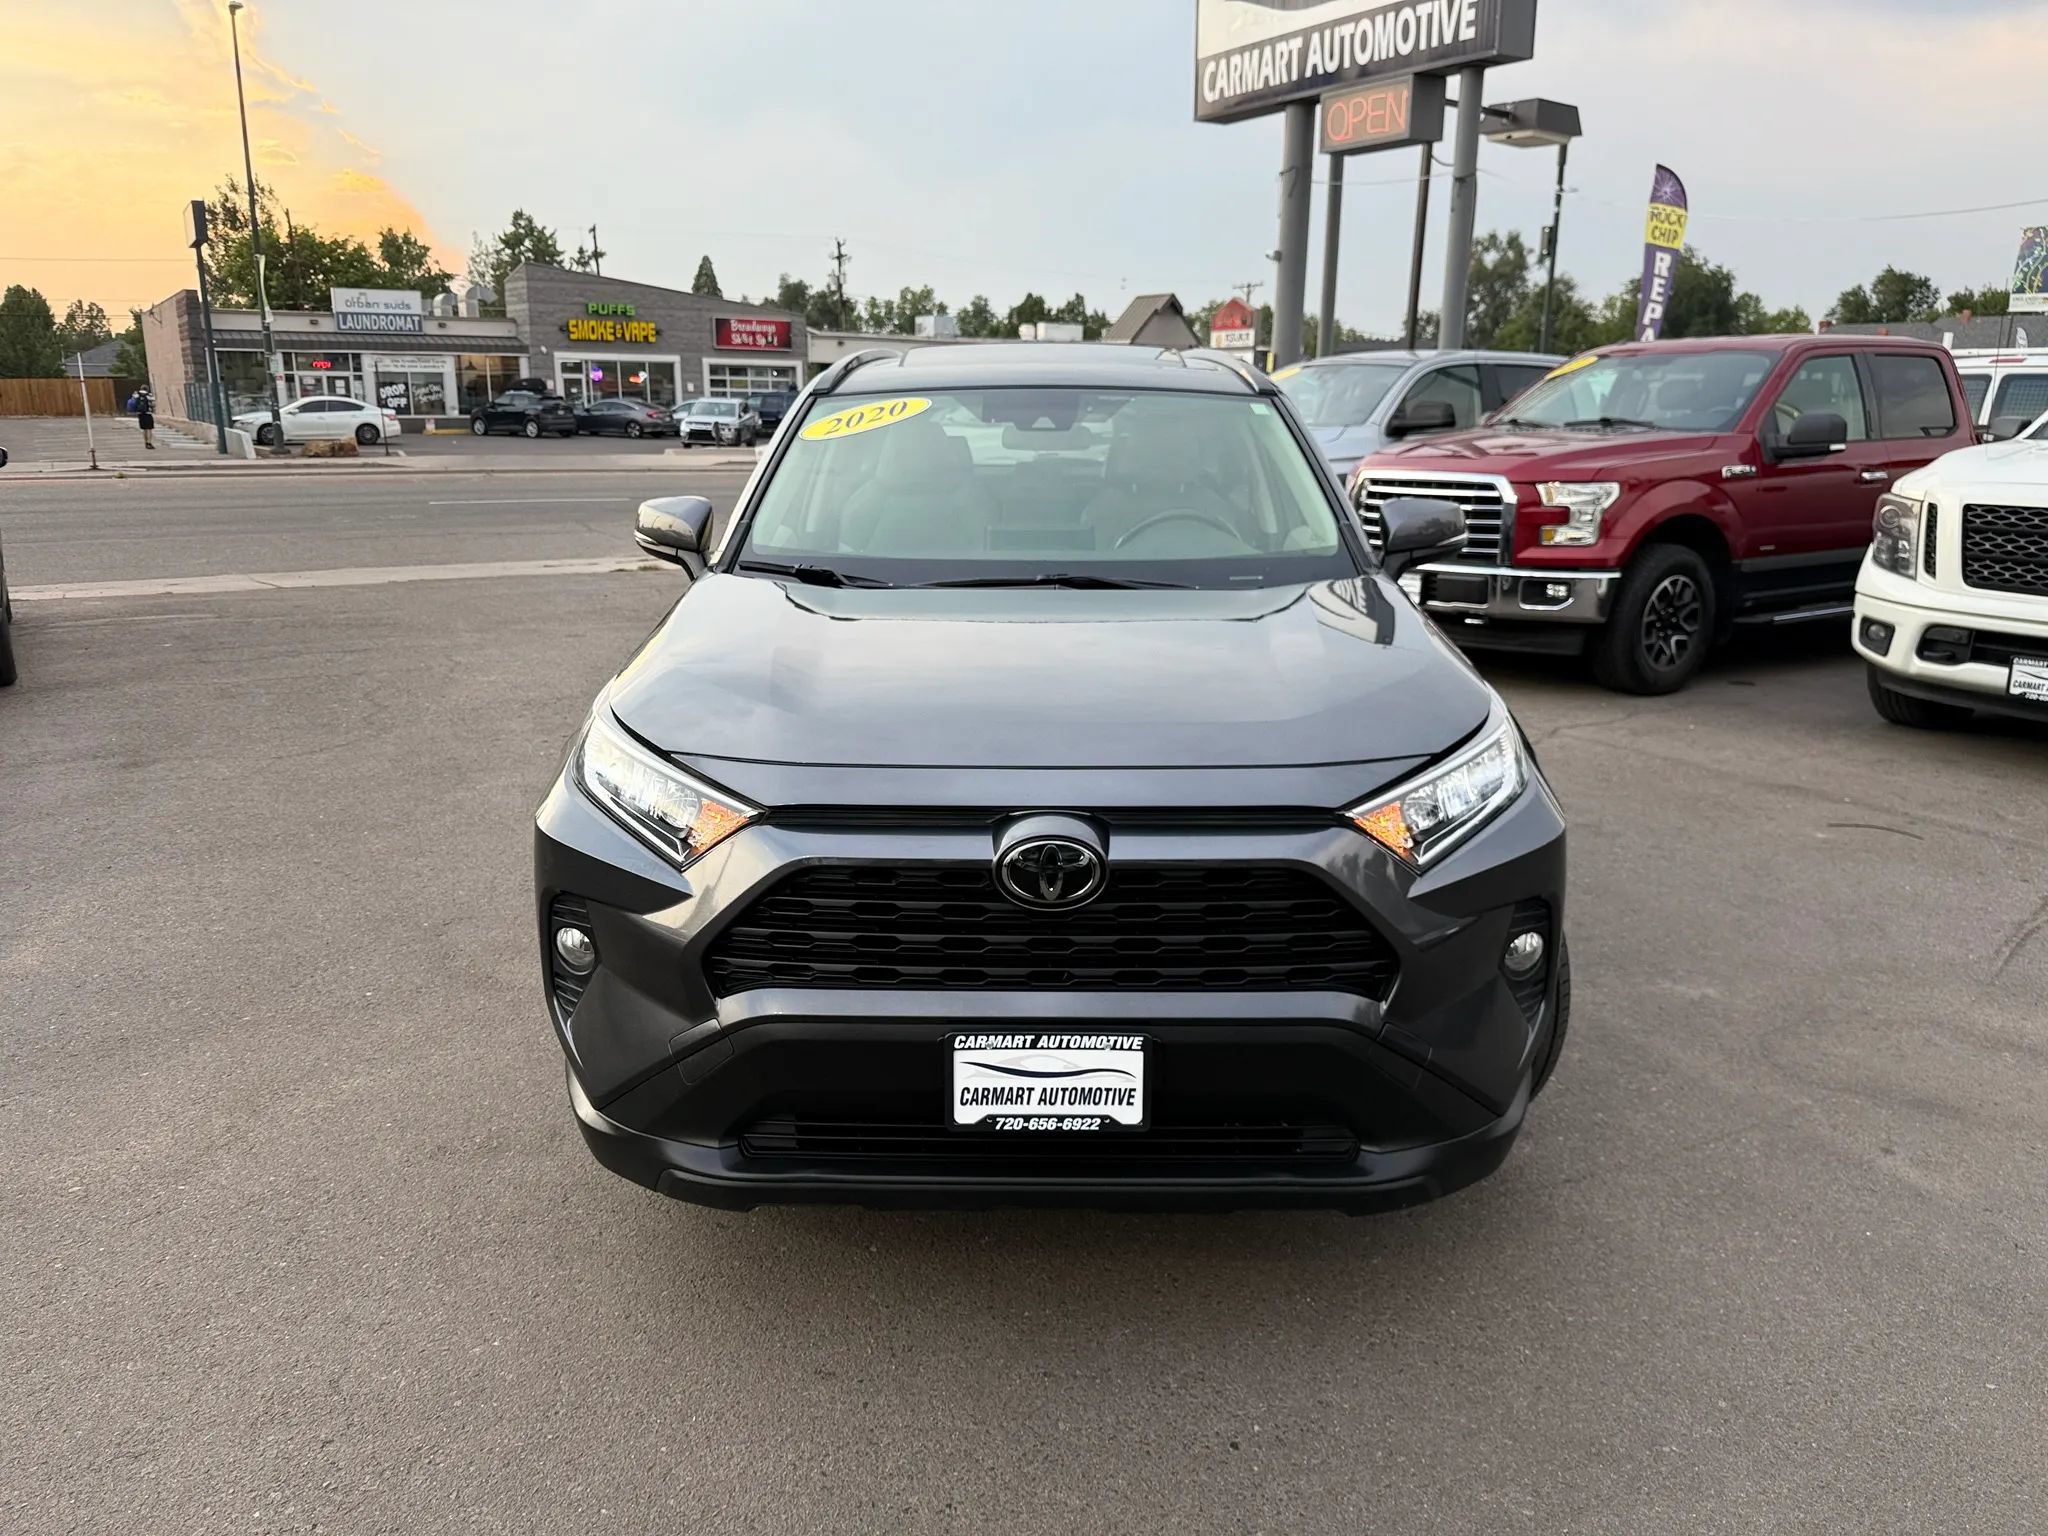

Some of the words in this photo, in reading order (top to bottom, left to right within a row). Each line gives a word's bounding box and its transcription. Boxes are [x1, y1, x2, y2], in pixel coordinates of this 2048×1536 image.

[1202, 36, 1304, 103] CARMART
[1305, 0, 1479, 78] AUTOMOTIVE
[1326, 91, 1409, 142] OPEN
[1651, 226, 1679, 245] CHIP
[587, 303, 636, 316] PUFFS
[338, 313, 420, 332] LAUNDROMAT
[568, 319, 615, 341] SMOKE
[623, 321, 656, 343] VAPE
[379, 384, 406, 399] DROP
[386, 397, 408, 409] OFF
[824, 401, 908, 436] 2020
[2013, 680, 2045, 691] CARMART
[954, 1034, 1034, 1049] CARMART
[1036, 1035, 1144, 1051] AUTOMOTIVE
[959, 1086, 1035, 1107] CARMART
[1037, 1086, 1137, 1107] AUTOMOTIVE
[994, 1116, 1102, 1131] 720-656-6922
